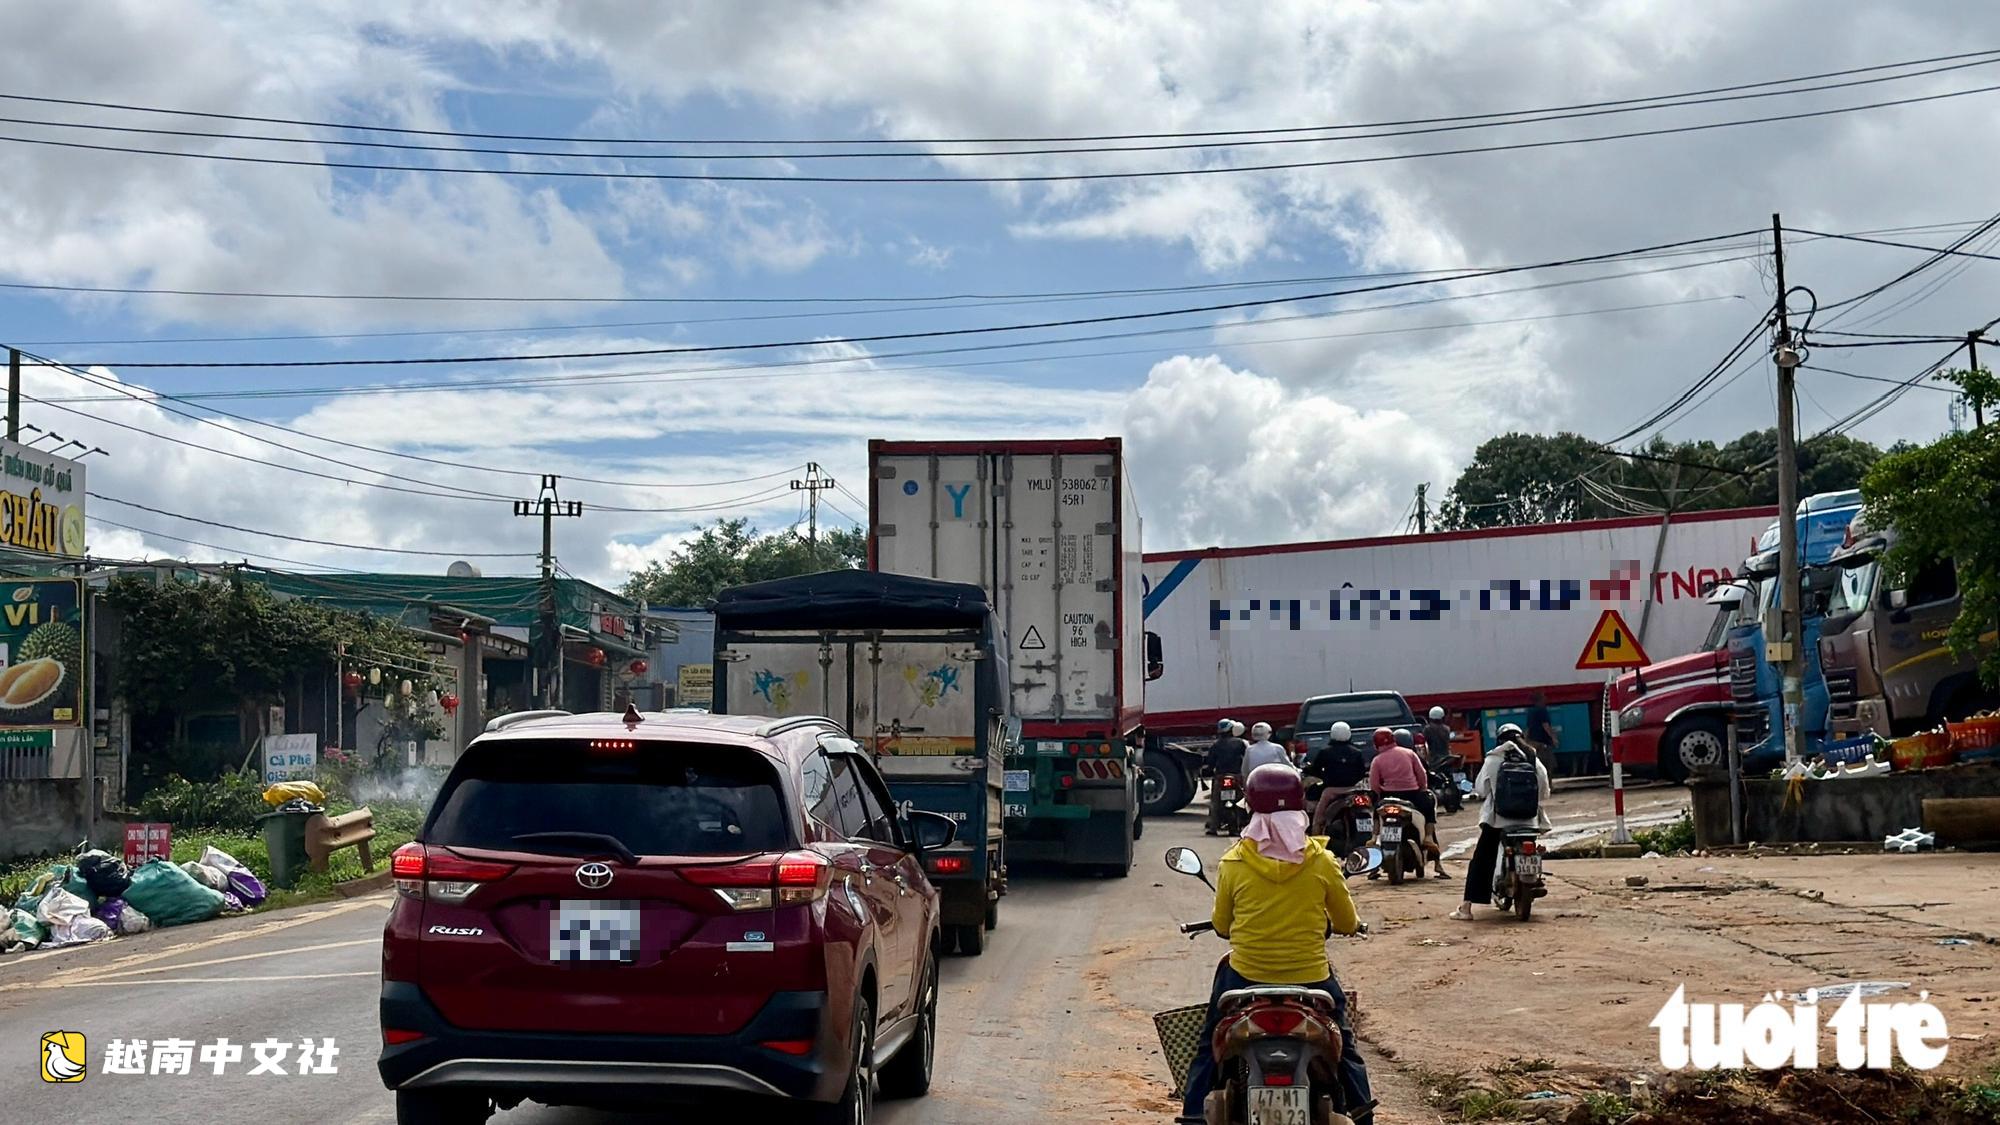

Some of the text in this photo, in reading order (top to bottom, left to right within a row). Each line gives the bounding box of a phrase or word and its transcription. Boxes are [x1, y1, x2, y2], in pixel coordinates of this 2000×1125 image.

[1027, 479, 1052, 491] YMLU
[1061, 479, 1097, 490] 538062
[944, 484, 971, 518] Y
[1062, 494, 1085, 505] 45R1
[0, 487, 59, 553] CHÂU
[1063, 613, 1094, 625] CAUTION
[1070, 636, 1087, 648] HIGH
[289, 754, 312, 766] Phê
[429, 926, 483, 936] Rush
